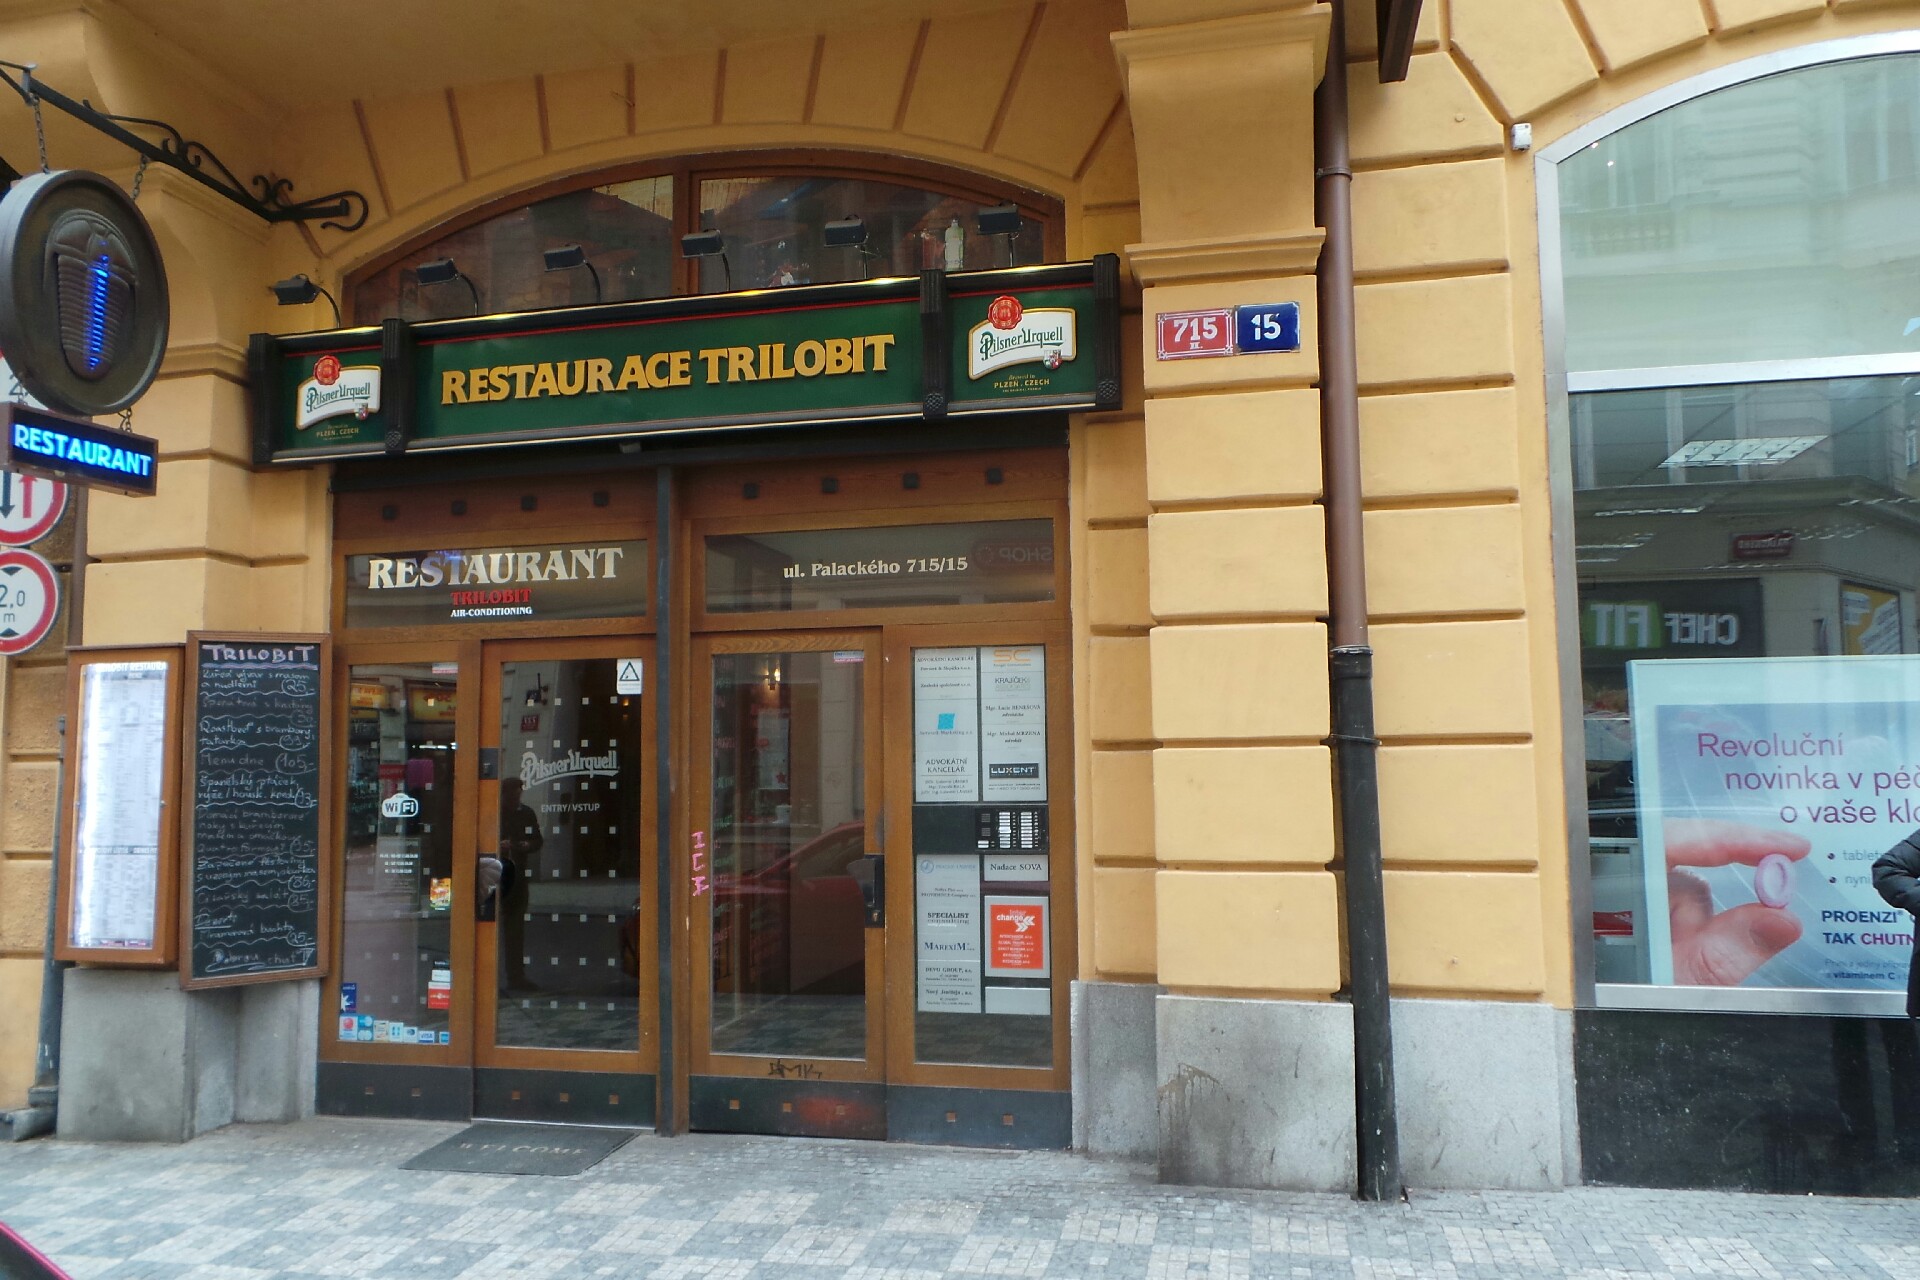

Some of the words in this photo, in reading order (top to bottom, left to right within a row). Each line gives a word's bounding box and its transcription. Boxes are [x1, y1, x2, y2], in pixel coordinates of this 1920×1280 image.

[1174, 317, 1218, 342] 715
[1251, 313, 1281, 341] 15
[980, 331, 1022, 361] Pilsner
[1021, 327, 1063, 349] Urquell
[440, 350, 692, 405] RESTAURACE
[699, 333, 895, 384] TRILOBIT
[306, 387, 340, 413] Pilsner
[339, 382, 371, 402] Urquell
[339, 427, 359, 435] CZECH
[13, 424, 152, 476] RESTAURANT
[368, 547, 624, 589] RESTAURANT
[783, 564, 806, 579] ul.
[811, 560, 901, 577] Palackého
[906, 557, 969, 573] 715/15
[451, 588, 533, 606] TRILOBIT
[3, 612, 16, 623] m
[450, 606, 533, 618] AIR-CONDITIONING
[1697, 731, 1844, 758] Revoluční
[520, 751, 571, 790] Pilsner
[568, 750, 618, 779] Urquell
[925, 758, 968, 766] ADVOKÁTNÍ
[991, 766, 1034, 774] LUXENT
[1725, 765, 1840, 790] novinka
[1847, 772, 1864, 790] v
[573, 802, 600, 813] VSTUP
[1779, 805, 1798, 823] o
[1808, 798, 1877, 823] vaše
[990, 863, 1017, 871] Nadace
[1019, 863, 1042, 871] SOVA
[996, 914, 1025, 923] change
[1822, 932, 1856, 945] TAK
[1887, 972, 1895, 980] C
